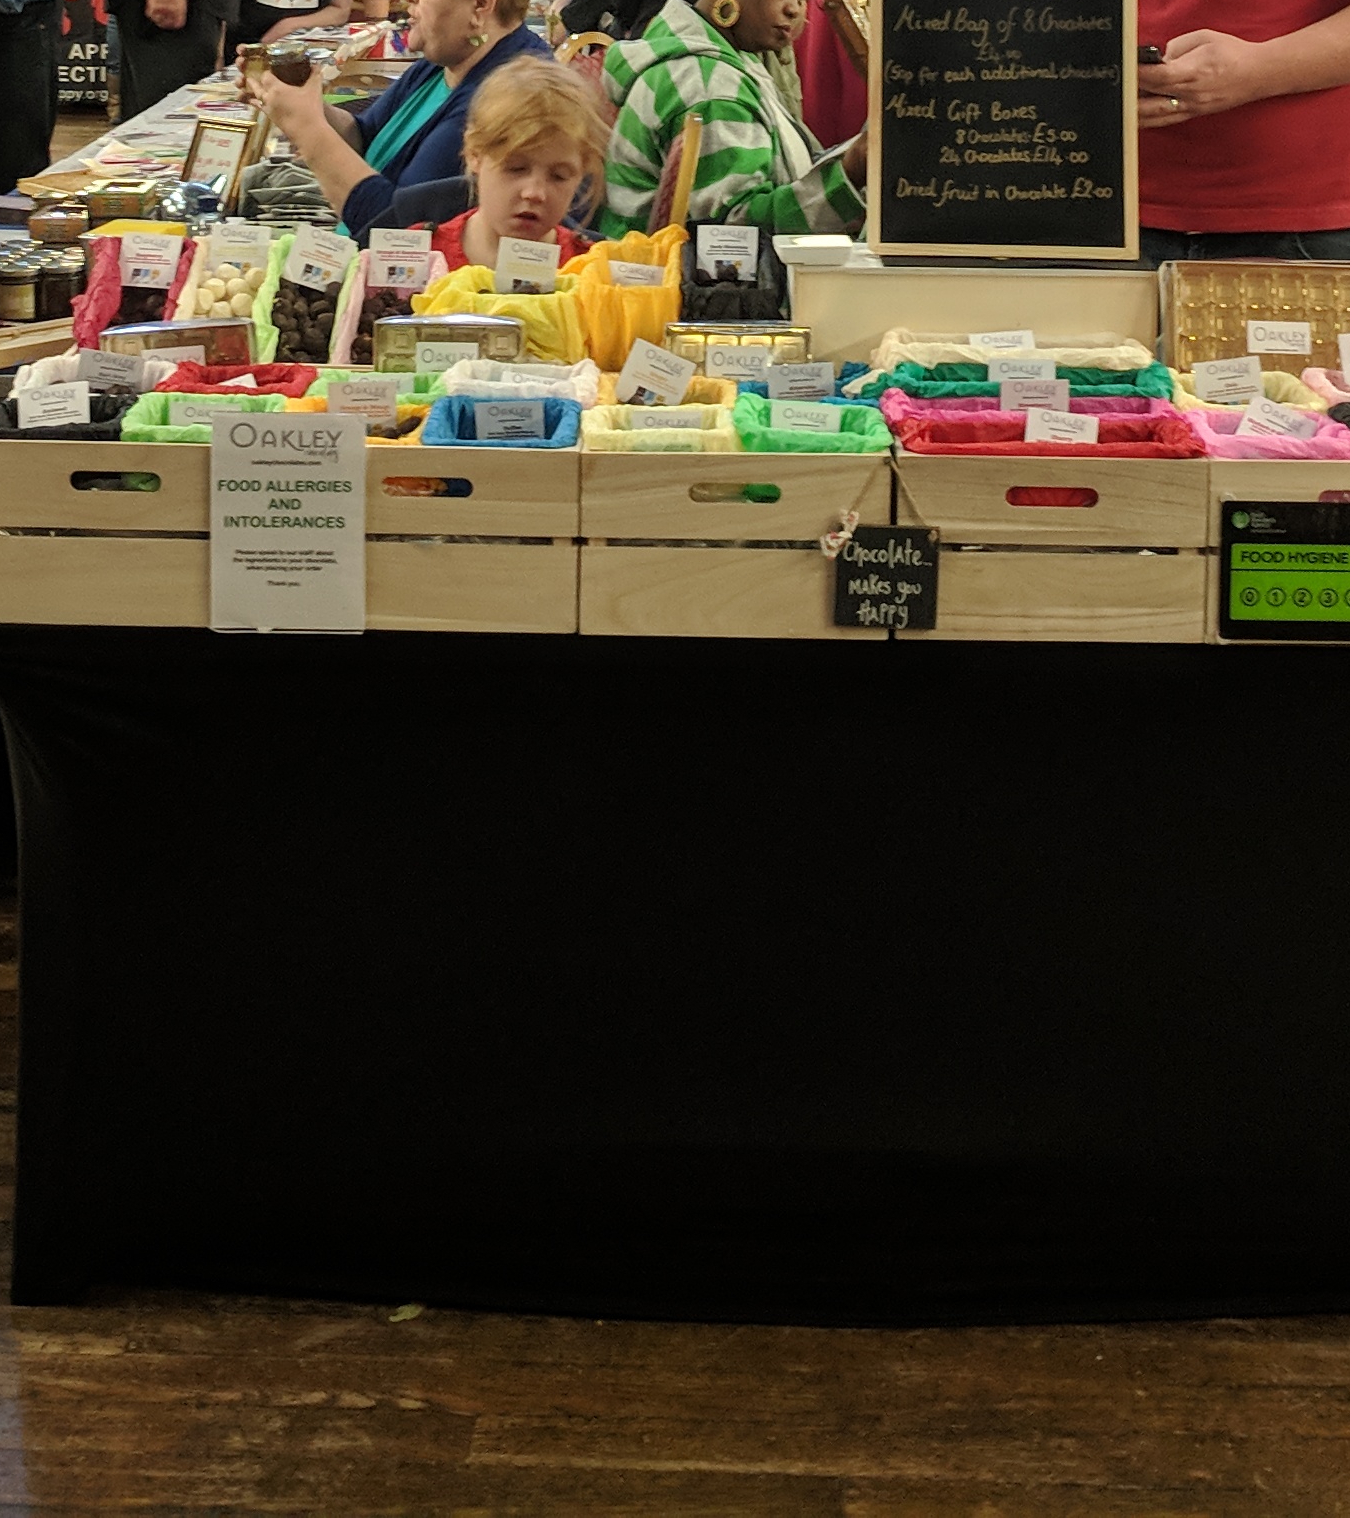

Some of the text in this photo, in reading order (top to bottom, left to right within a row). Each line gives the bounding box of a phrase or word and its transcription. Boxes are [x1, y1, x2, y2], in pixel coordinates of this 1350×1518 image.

[893, 4, 951, 32] Mixed
[953, 7, 990, 47] Bag
[996, 6, 1019, 44] of
[1022, 8, 1035, 32] 8
[943, 65, 976, 83] each
[885, 93, 1038, 124] Mixed Gift Boxes
[955, 129, 966, 144] 8
[939, 145, 960, 166] 24
[896, 177, 938, 198] Dried
[932, 179, 981, 208] fruit
[984, 185, 1001, 200] in
[1254, 326, 1306, 343] OAKLEY
[230, 422, 343, 452] OAKLEY
[217, 479, 353, 493] FOOD ALLERGIES
[268, 498, 302, 510] AND
[224, 515, 346, 529] INTOLERANCES
[1241, 551, 1285, 564] FOOD
[1288, 552, 1349, 565] HYGIENE
[894, 581, 923, 604] you
